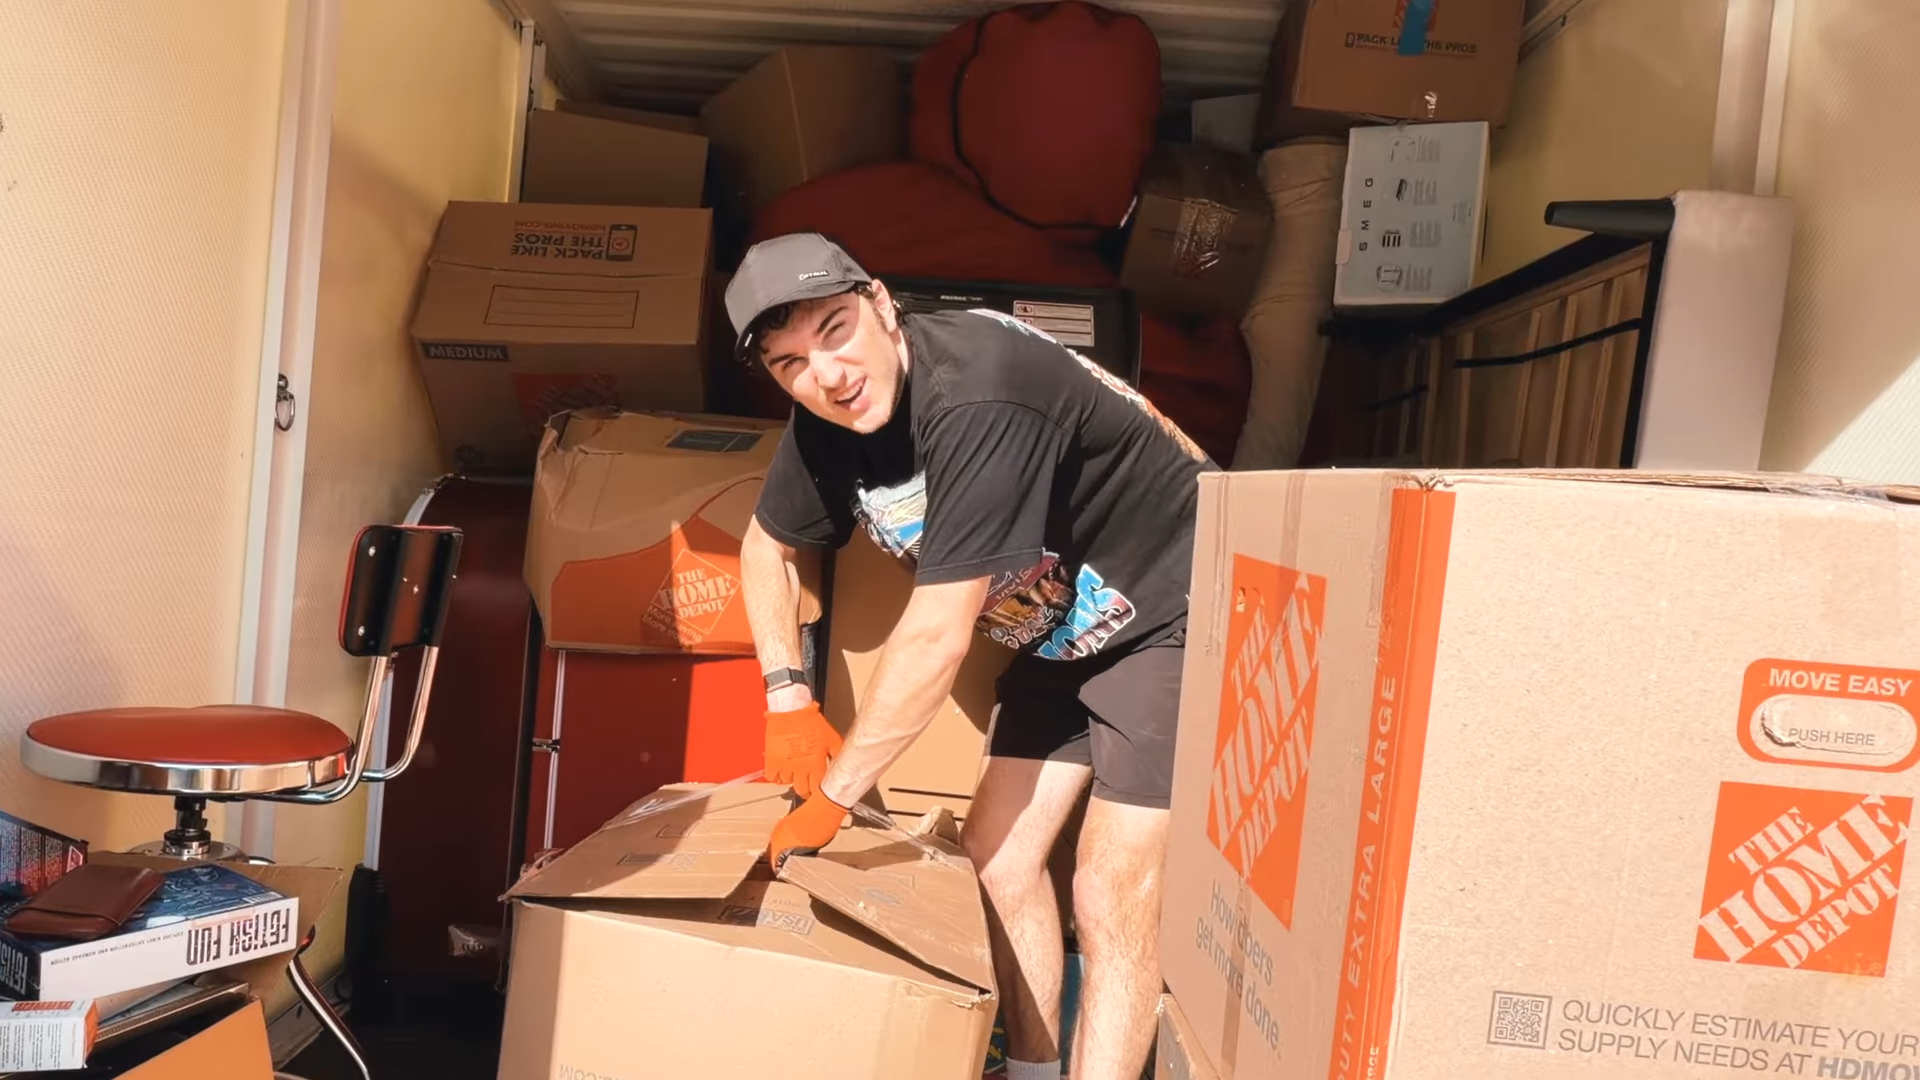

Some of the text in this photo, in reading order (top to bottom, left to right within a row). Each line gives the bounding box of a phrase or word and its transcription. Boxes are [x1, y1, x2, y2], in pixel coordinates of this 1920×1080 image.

[1356, 33, 1388, 45] PACK
[1445, 42, 1477, 54] PROS
[513, 233, 605, 249] THE PROS
[1358, 177, 1374, 252] SMEG
[509, 244, 605, 260] PACK LIKE
[428, 345, 507, 360] MEDIUM
[659, 573, 736, 610] HOME
[676, 567, 707, 585] THE
[678, 599, 726, 619] DEPOT
[1230, 592, 1270, 702] THE
[1768, 668, 1912, 697] MOVE EASY
[1211, 571, 1327, 854] HOME
[1788, 727, 1876, 747] PUSH HERE
[1239, 705, 1311, 882] DEPOT
[1347, 843, 1376, 989] EXTRA
[1365, 676, 1397, 825] LARGE
[1728, 805, 1815, 876] THE
[1699, 792, 1909, 963] HOME
[1210, 877, 1274, 987] How doers
[1771, 862, 1900, 970] DEPOT
[186, 924, 222, 966] FUN
[1195, 916, 1215, 959] get
[1214, 941, 1244, 1000] more
[1558, 1028, 1668, 1060] SUPPLY
[1674, 1040, 1770, 1071] NEEDS
[1774, 1051, 1813, 1076] AT
[1563, 999, 1920, 1057] QUICKLY ESTIMATE YOUR
